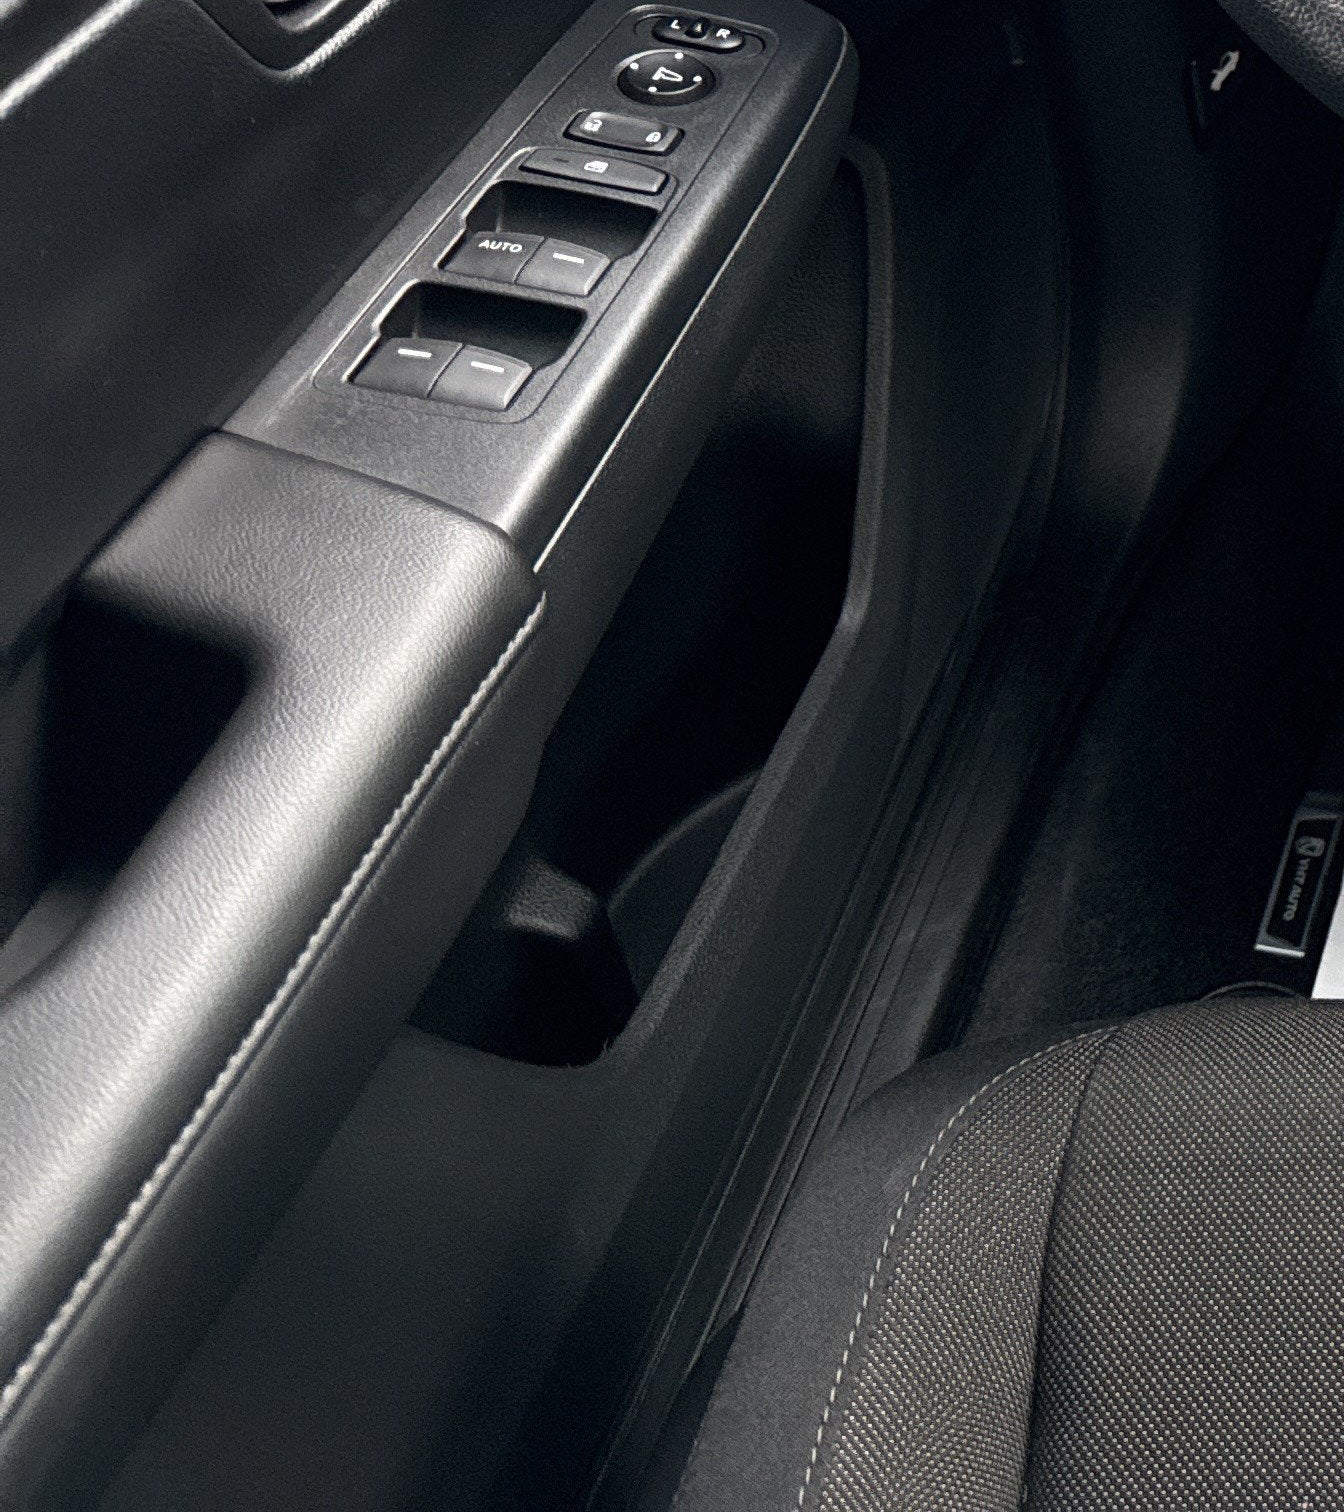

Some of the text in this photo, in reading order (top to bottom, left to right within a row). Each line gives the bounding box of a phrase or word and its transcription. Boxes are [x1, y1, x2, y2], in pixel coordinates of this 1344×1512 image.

[671, 19, 679, 29] L
[717, 28, 731, 39] R
[478, 239, 523, 254] AUTO
